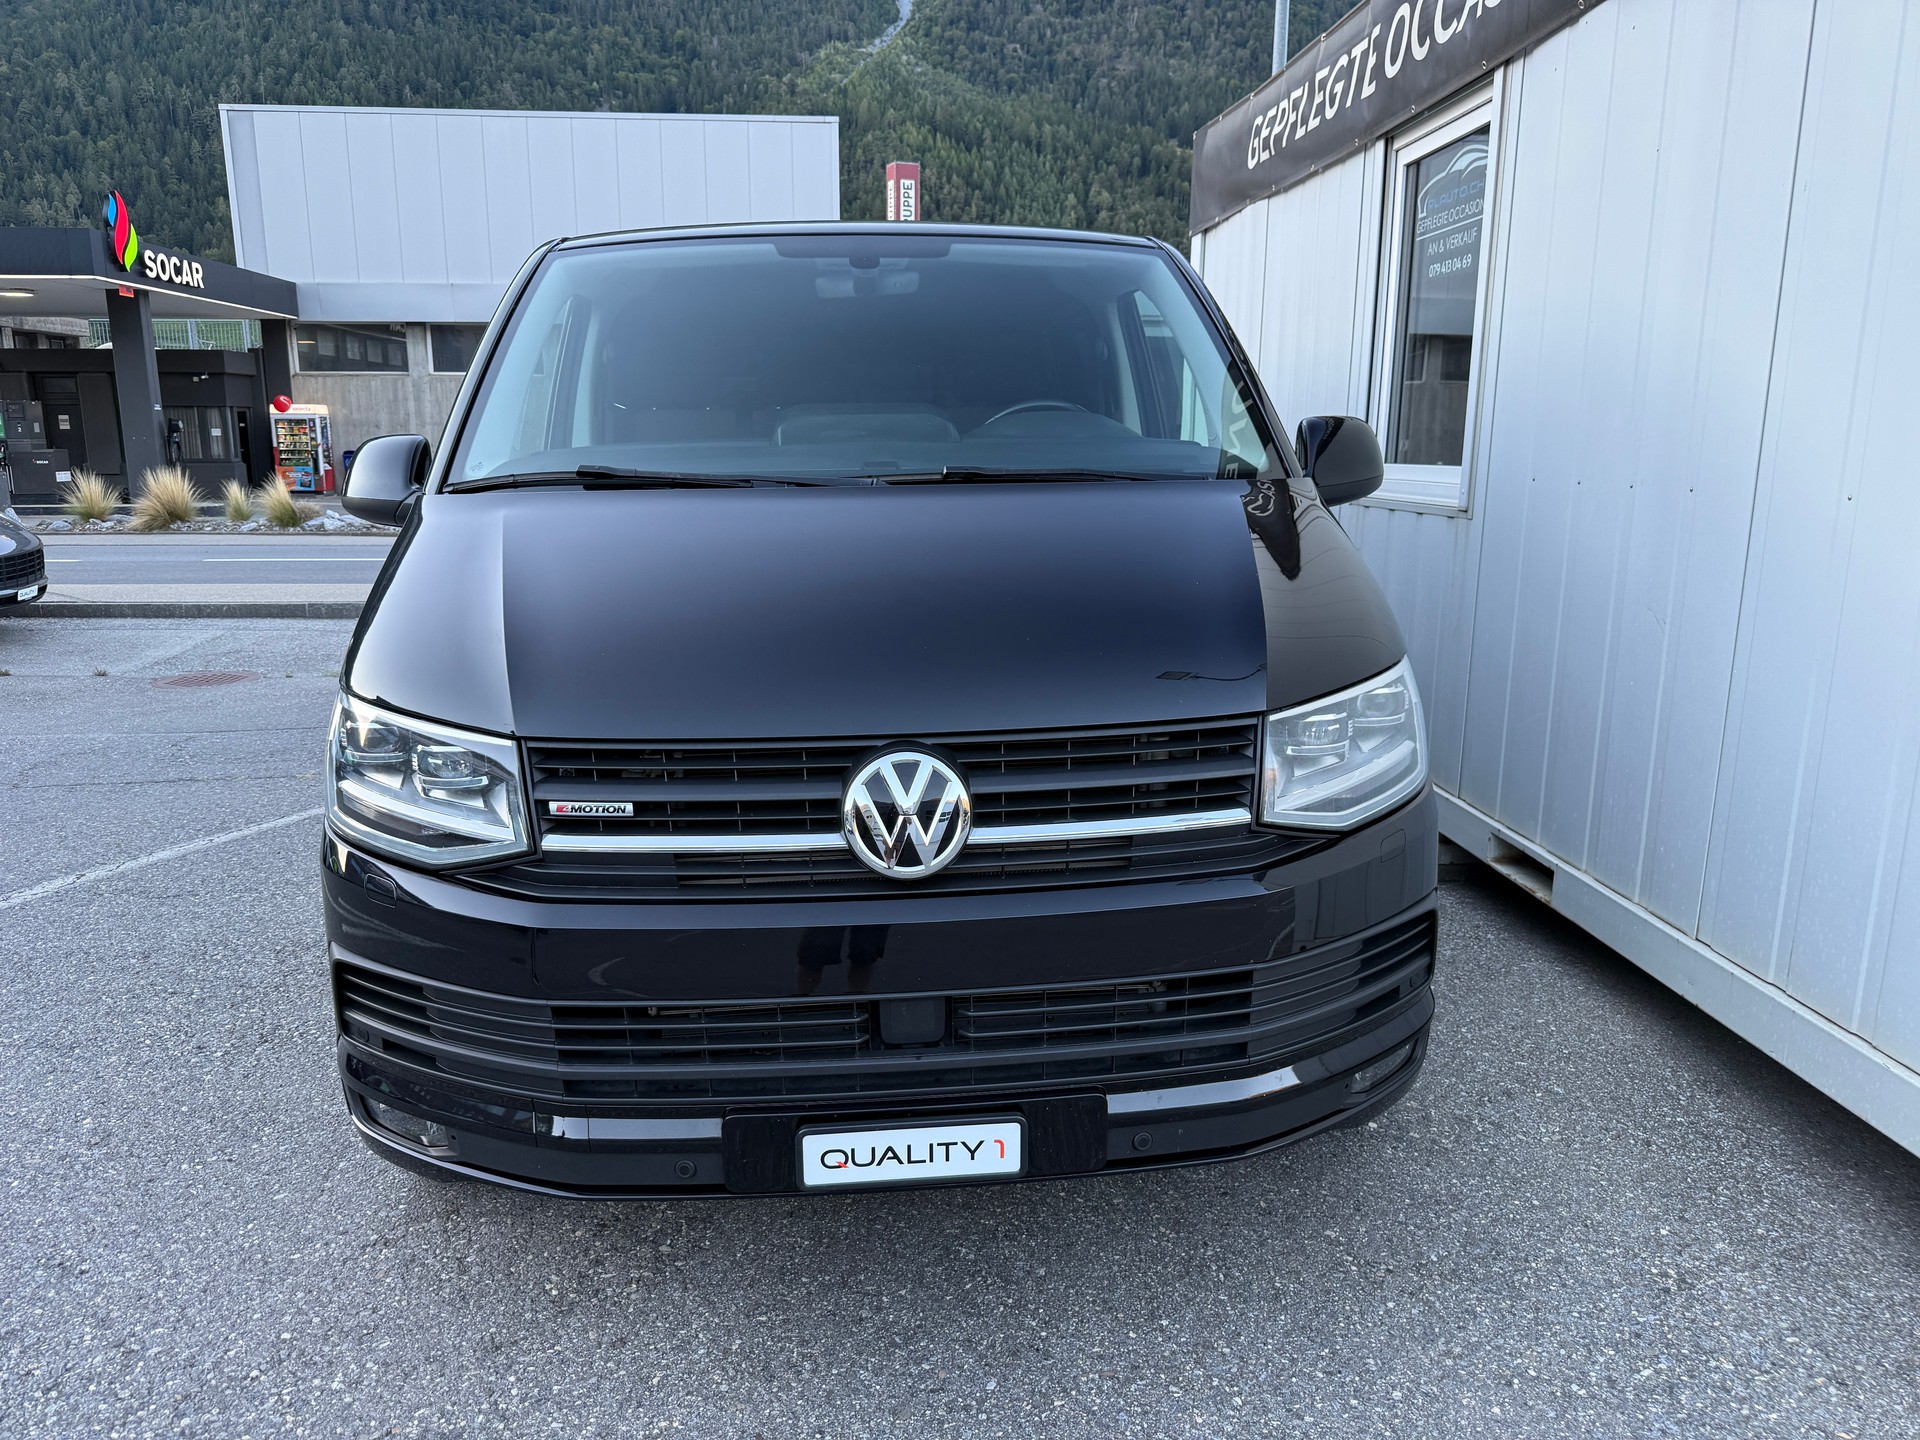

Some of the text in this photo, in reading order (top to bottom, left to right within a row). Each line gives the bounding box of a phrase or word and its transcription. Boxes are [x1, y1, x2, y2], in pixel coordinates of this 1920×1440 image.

[1247, 0, 1502, 170] GEPFLEGTE OCC
[903, 182, 913, 221] UPPE
[1416, 211, 1448, 234] GEPFLEGTE
[1427, 227, 1478, 256] AN & VERKAUF
[144, 249, 205, 289] SOCAR
[1428, 253, 1472, 278] 079 413 04 69
[820, 1139, 1005, 1170] QUALITY 1
